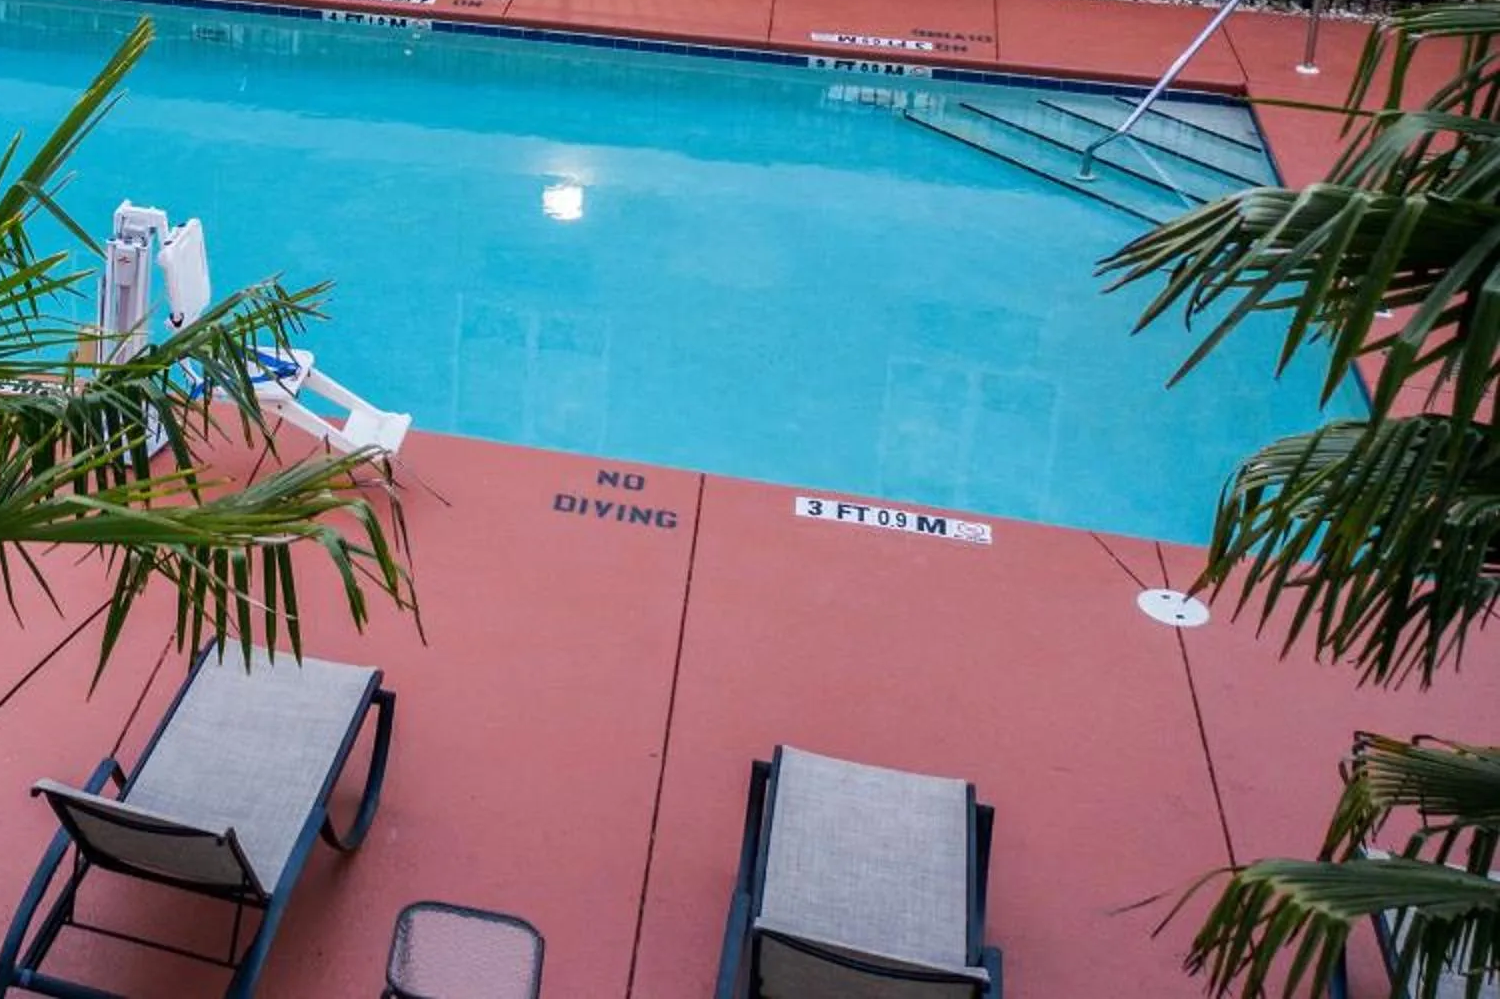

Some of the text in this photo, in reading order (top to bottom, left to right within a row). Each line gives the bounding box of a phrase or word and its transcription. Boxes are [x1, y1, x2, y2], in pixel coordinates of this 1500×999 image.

[833, 60, 856, 71] FT
[596, 468, 645, 491] NO
[552, 492, 678, 529] DIVING
[807, 499, 948, 536] 3 FT 0.9 M
